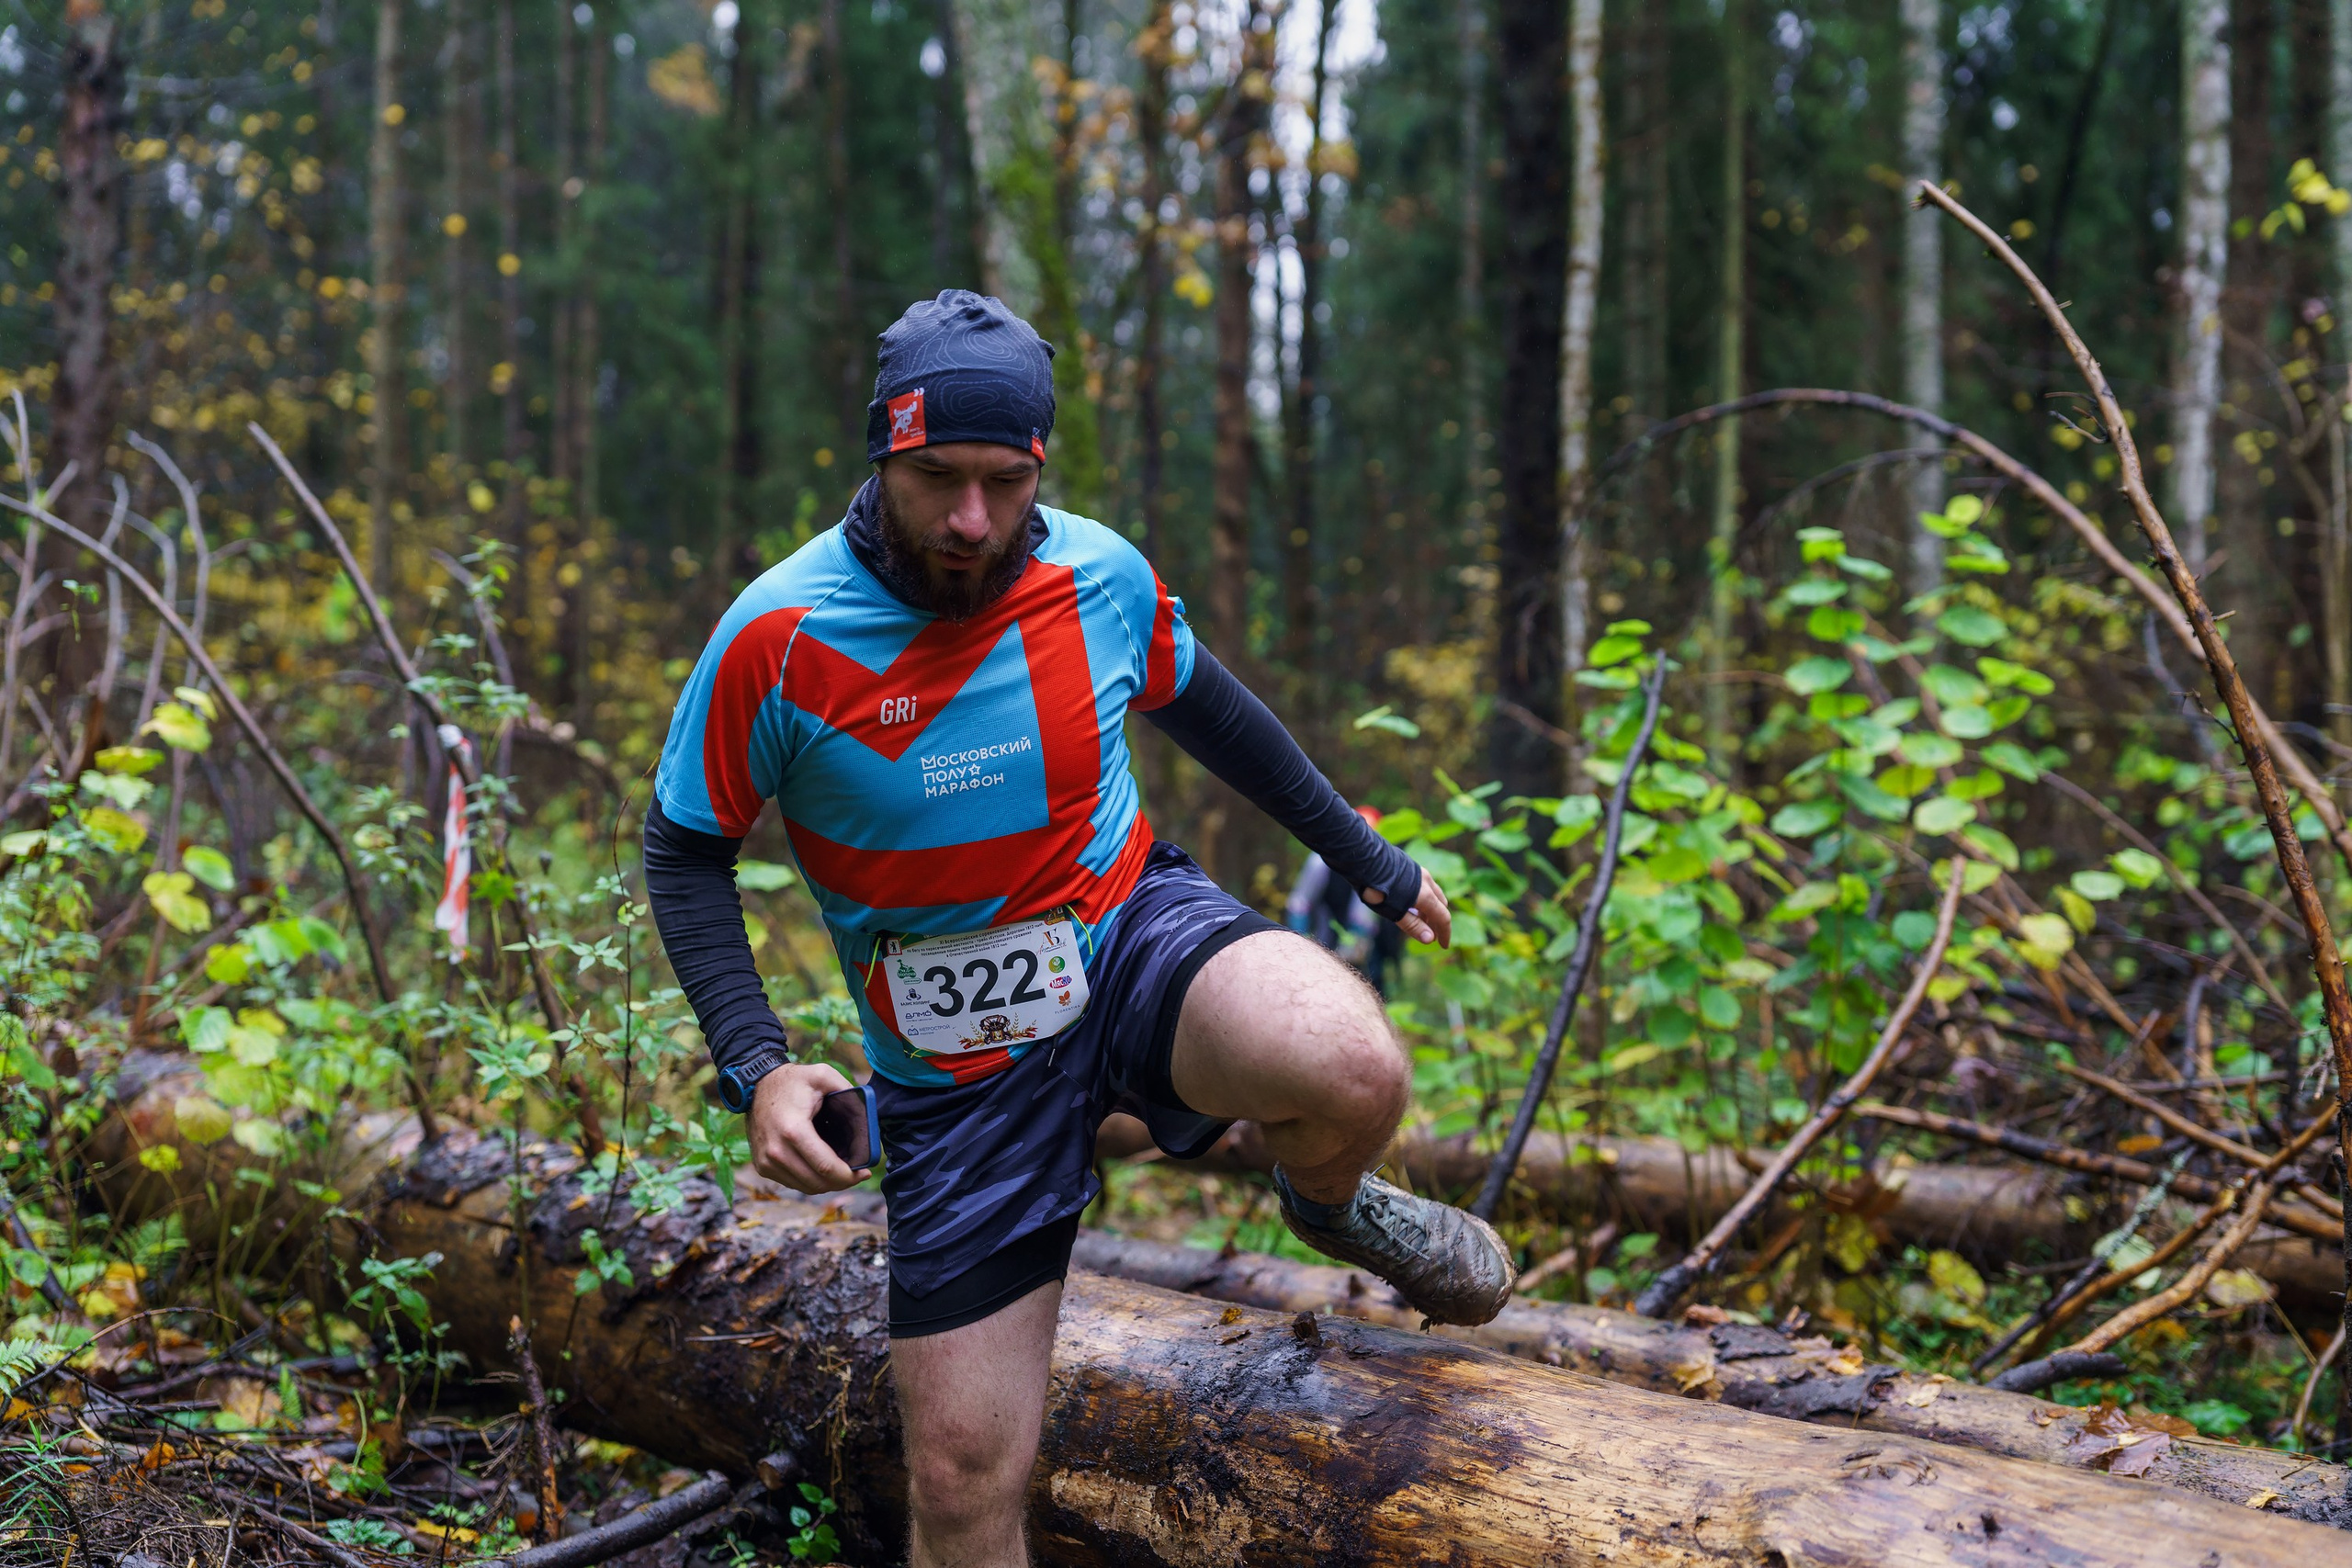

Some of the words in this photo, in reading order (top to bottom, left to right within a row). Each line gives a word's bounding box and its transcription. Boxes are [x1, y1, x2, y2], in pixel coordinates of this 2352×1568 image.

[879, 695, 918, 726] GRi
[921, 736, 1032, 770] МОСКОВСКИЙ
[923, 766, 967, 784] ПОЛУ
[925, 773, 1004, 798] МАРАФОН
[923, 948, 1046, 1018] 322
